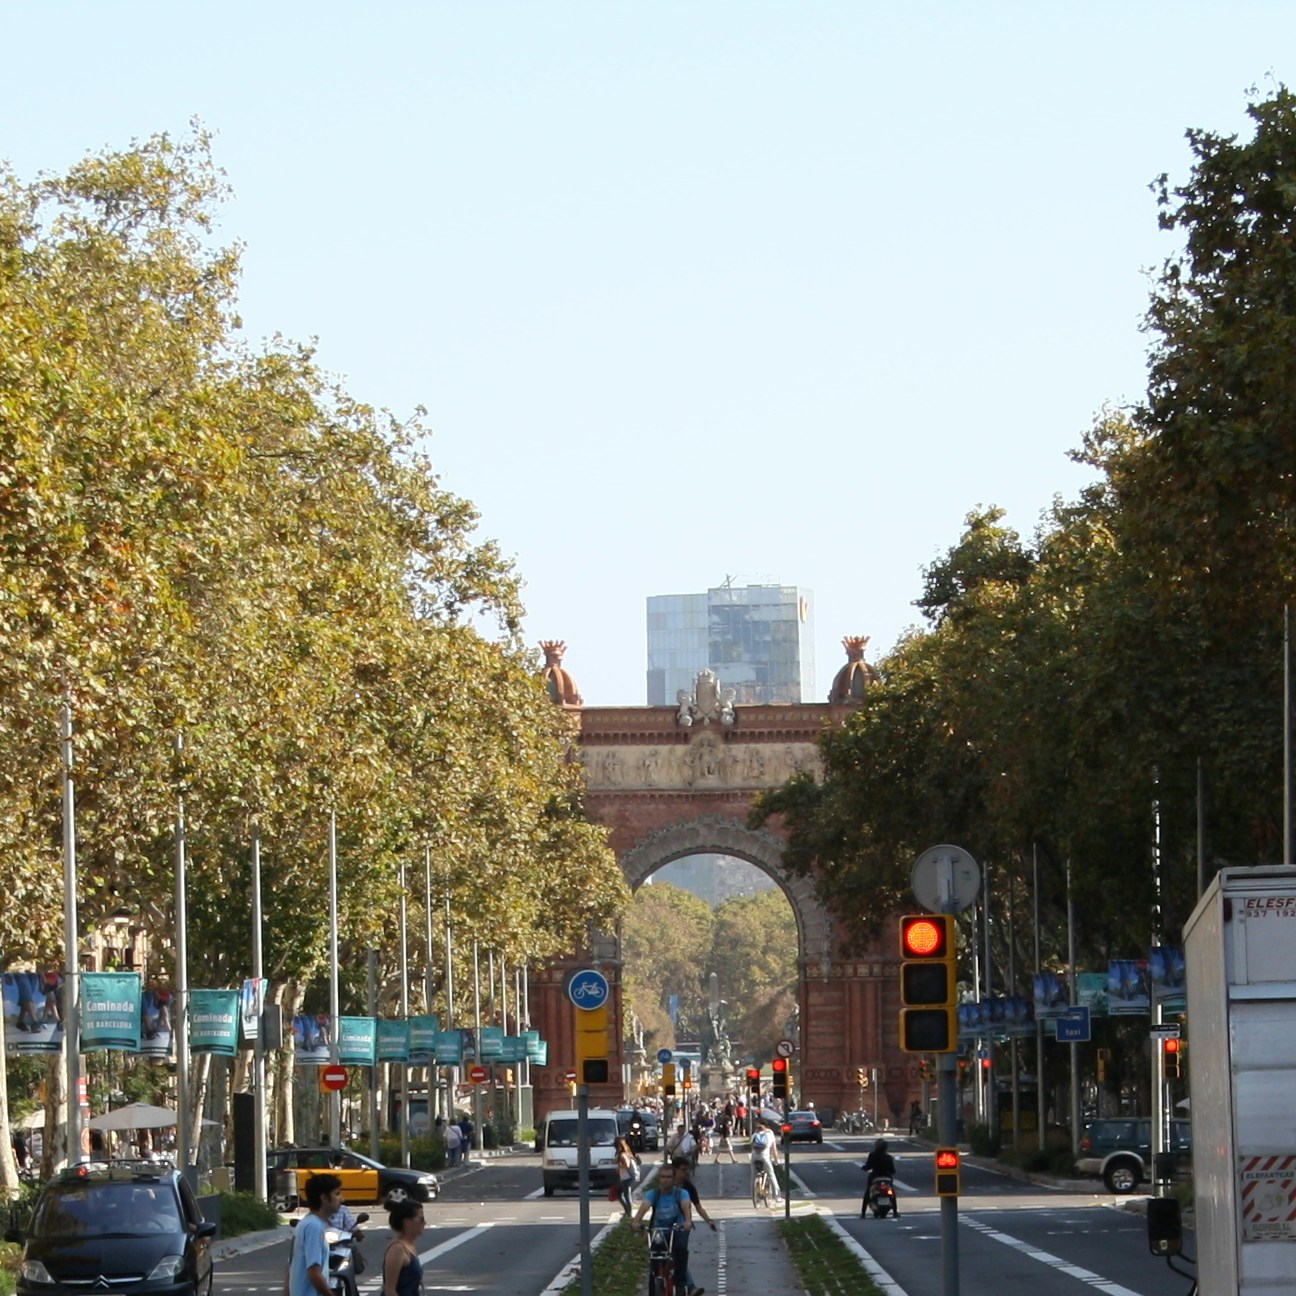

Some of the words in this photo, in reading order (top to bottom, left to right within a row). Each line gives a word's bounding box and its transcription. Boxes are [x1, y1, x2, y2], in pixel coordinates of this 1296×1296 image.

[1276, 909, 1296, 917] 192
[86, 1000, 134, 1012] Caminada
[1065, 1028, 1081, 1036] taxi
